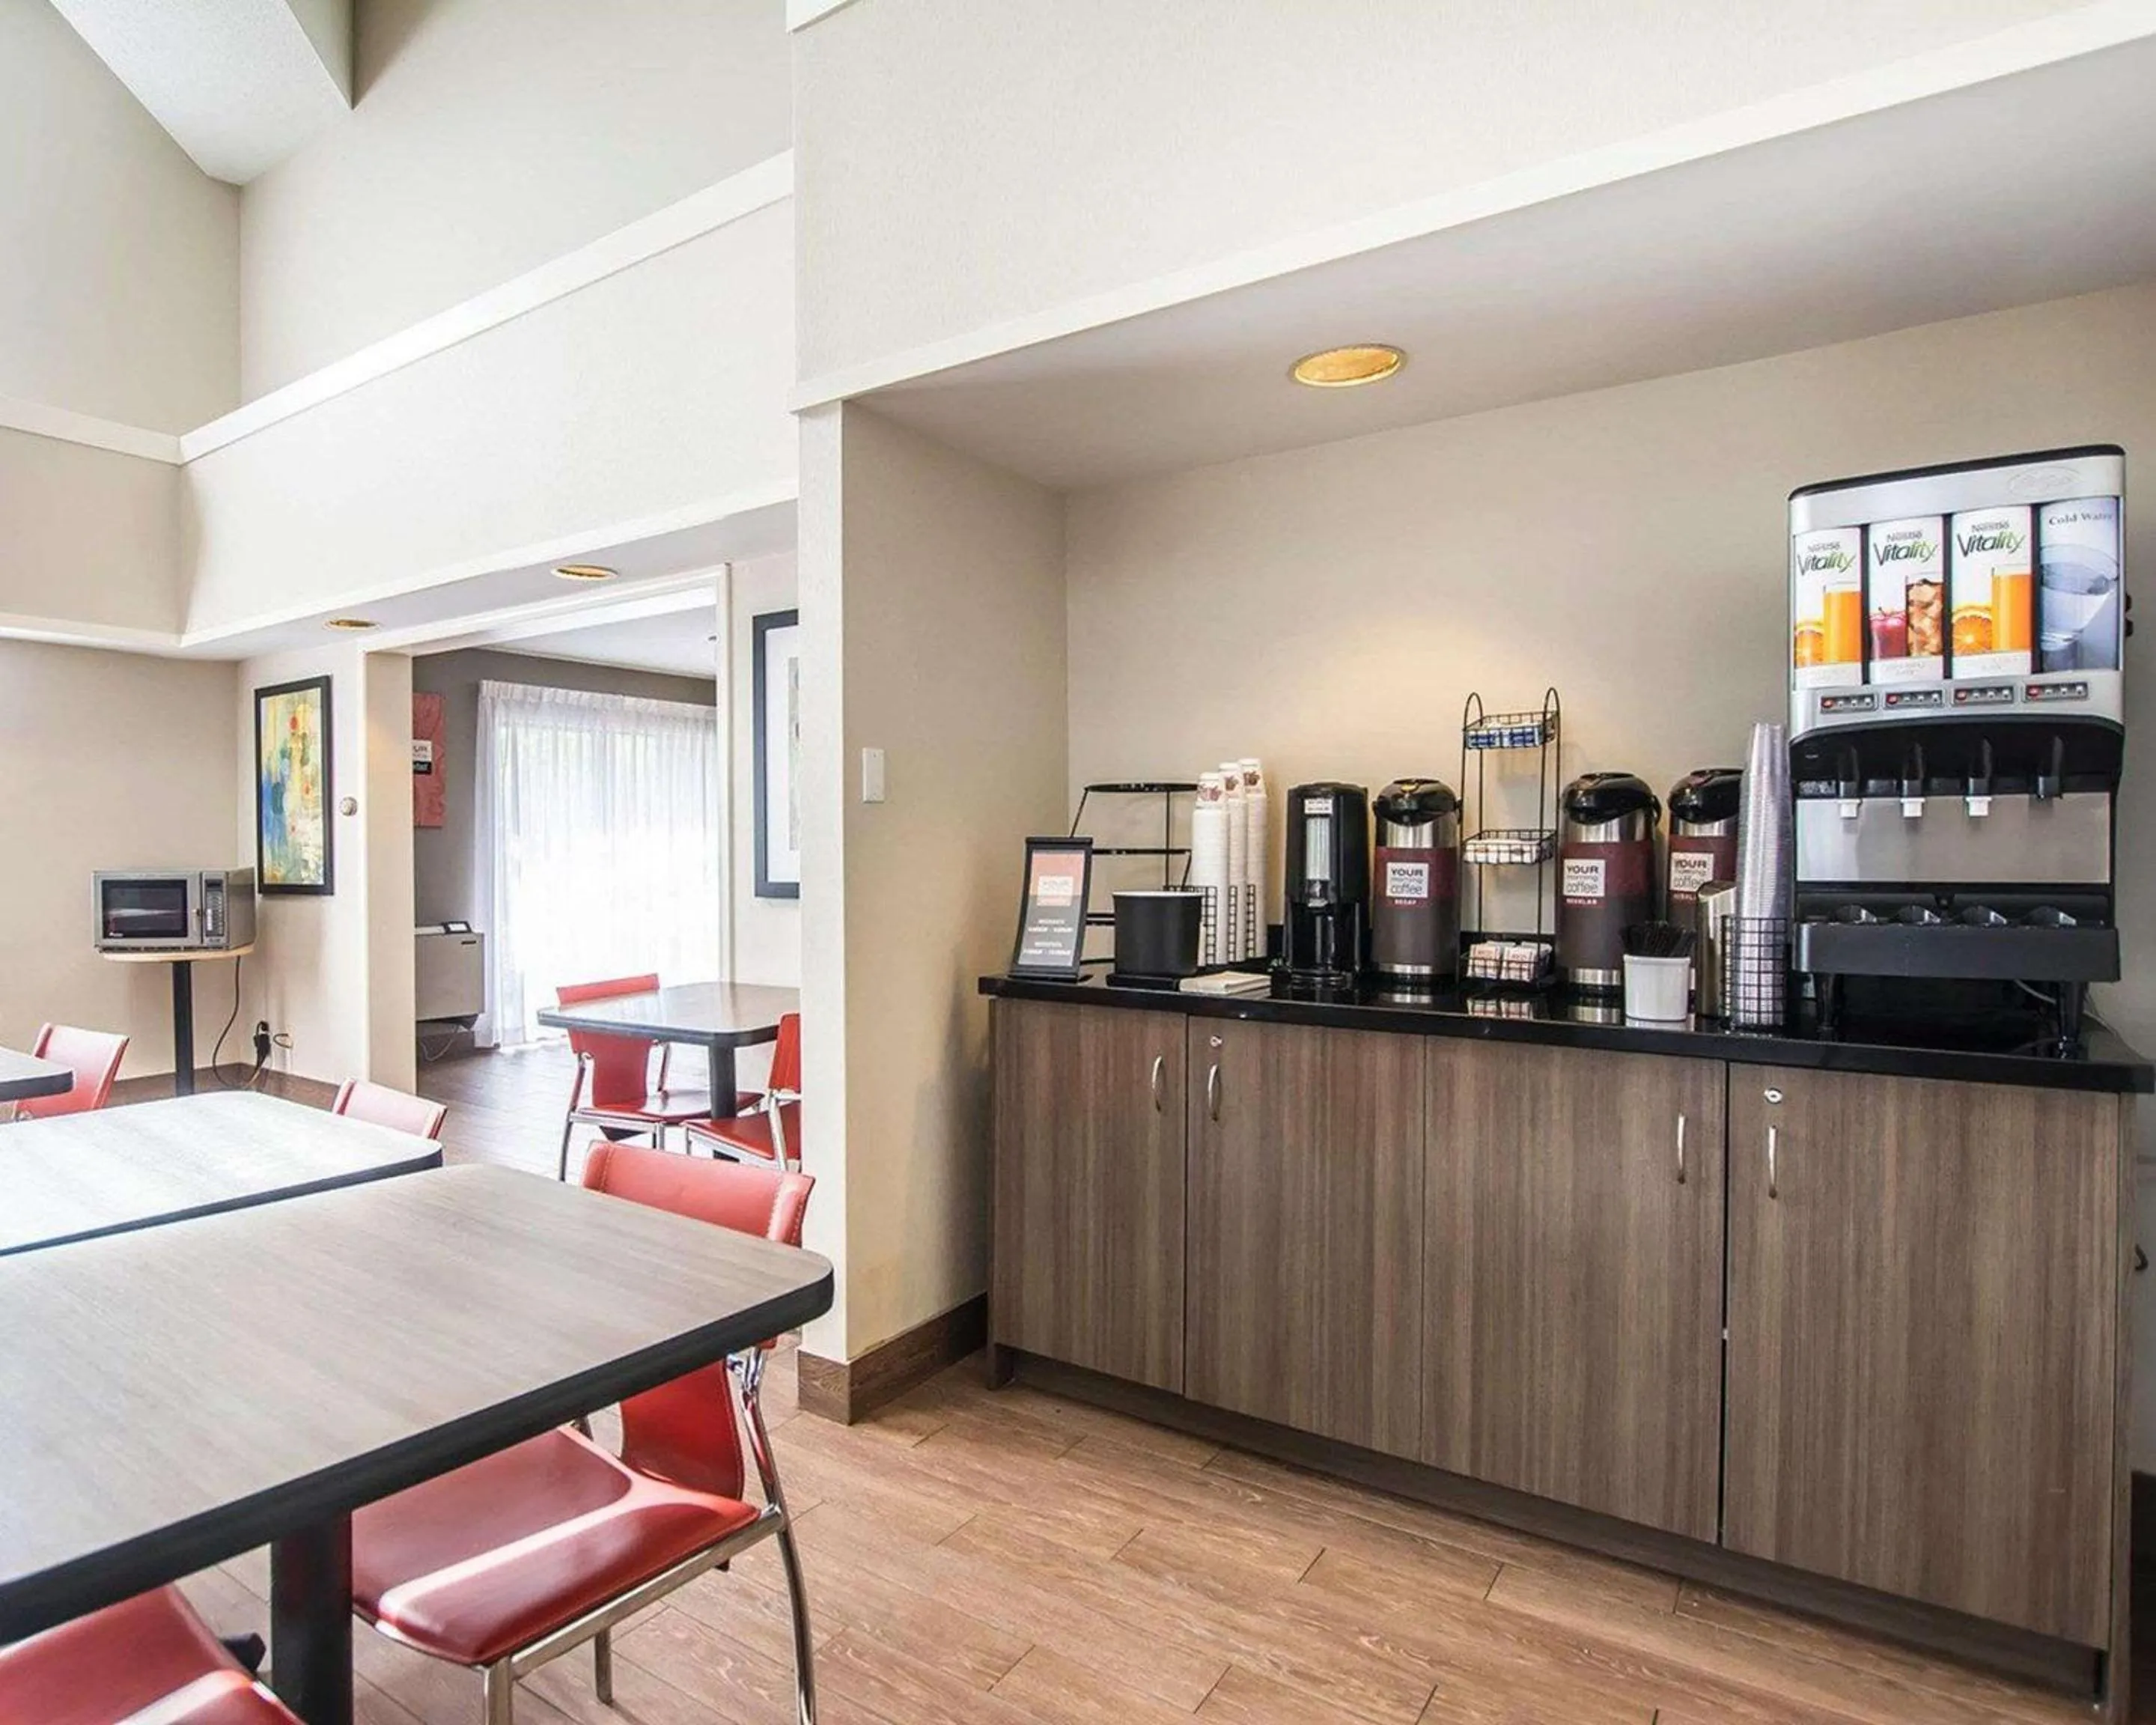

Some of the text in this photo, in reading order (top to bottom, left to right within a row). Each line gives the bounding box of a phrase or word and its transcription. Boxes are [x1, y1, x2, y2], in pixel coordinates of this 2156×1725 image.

[2048, 512, 2077, 526] Cold
[1957, 530, 2026, 558] Vitality
[1873, 540, 1938, 566] Vitality
[1797, 551, 1856, 576] Vitality
[1566, 865, 1599, 874] YOUR
[1675, 860, 1707, 868] YOUR
[1391, 868, 1423, 877] YOUR
[1566, 880, 1599, 893] coffee
